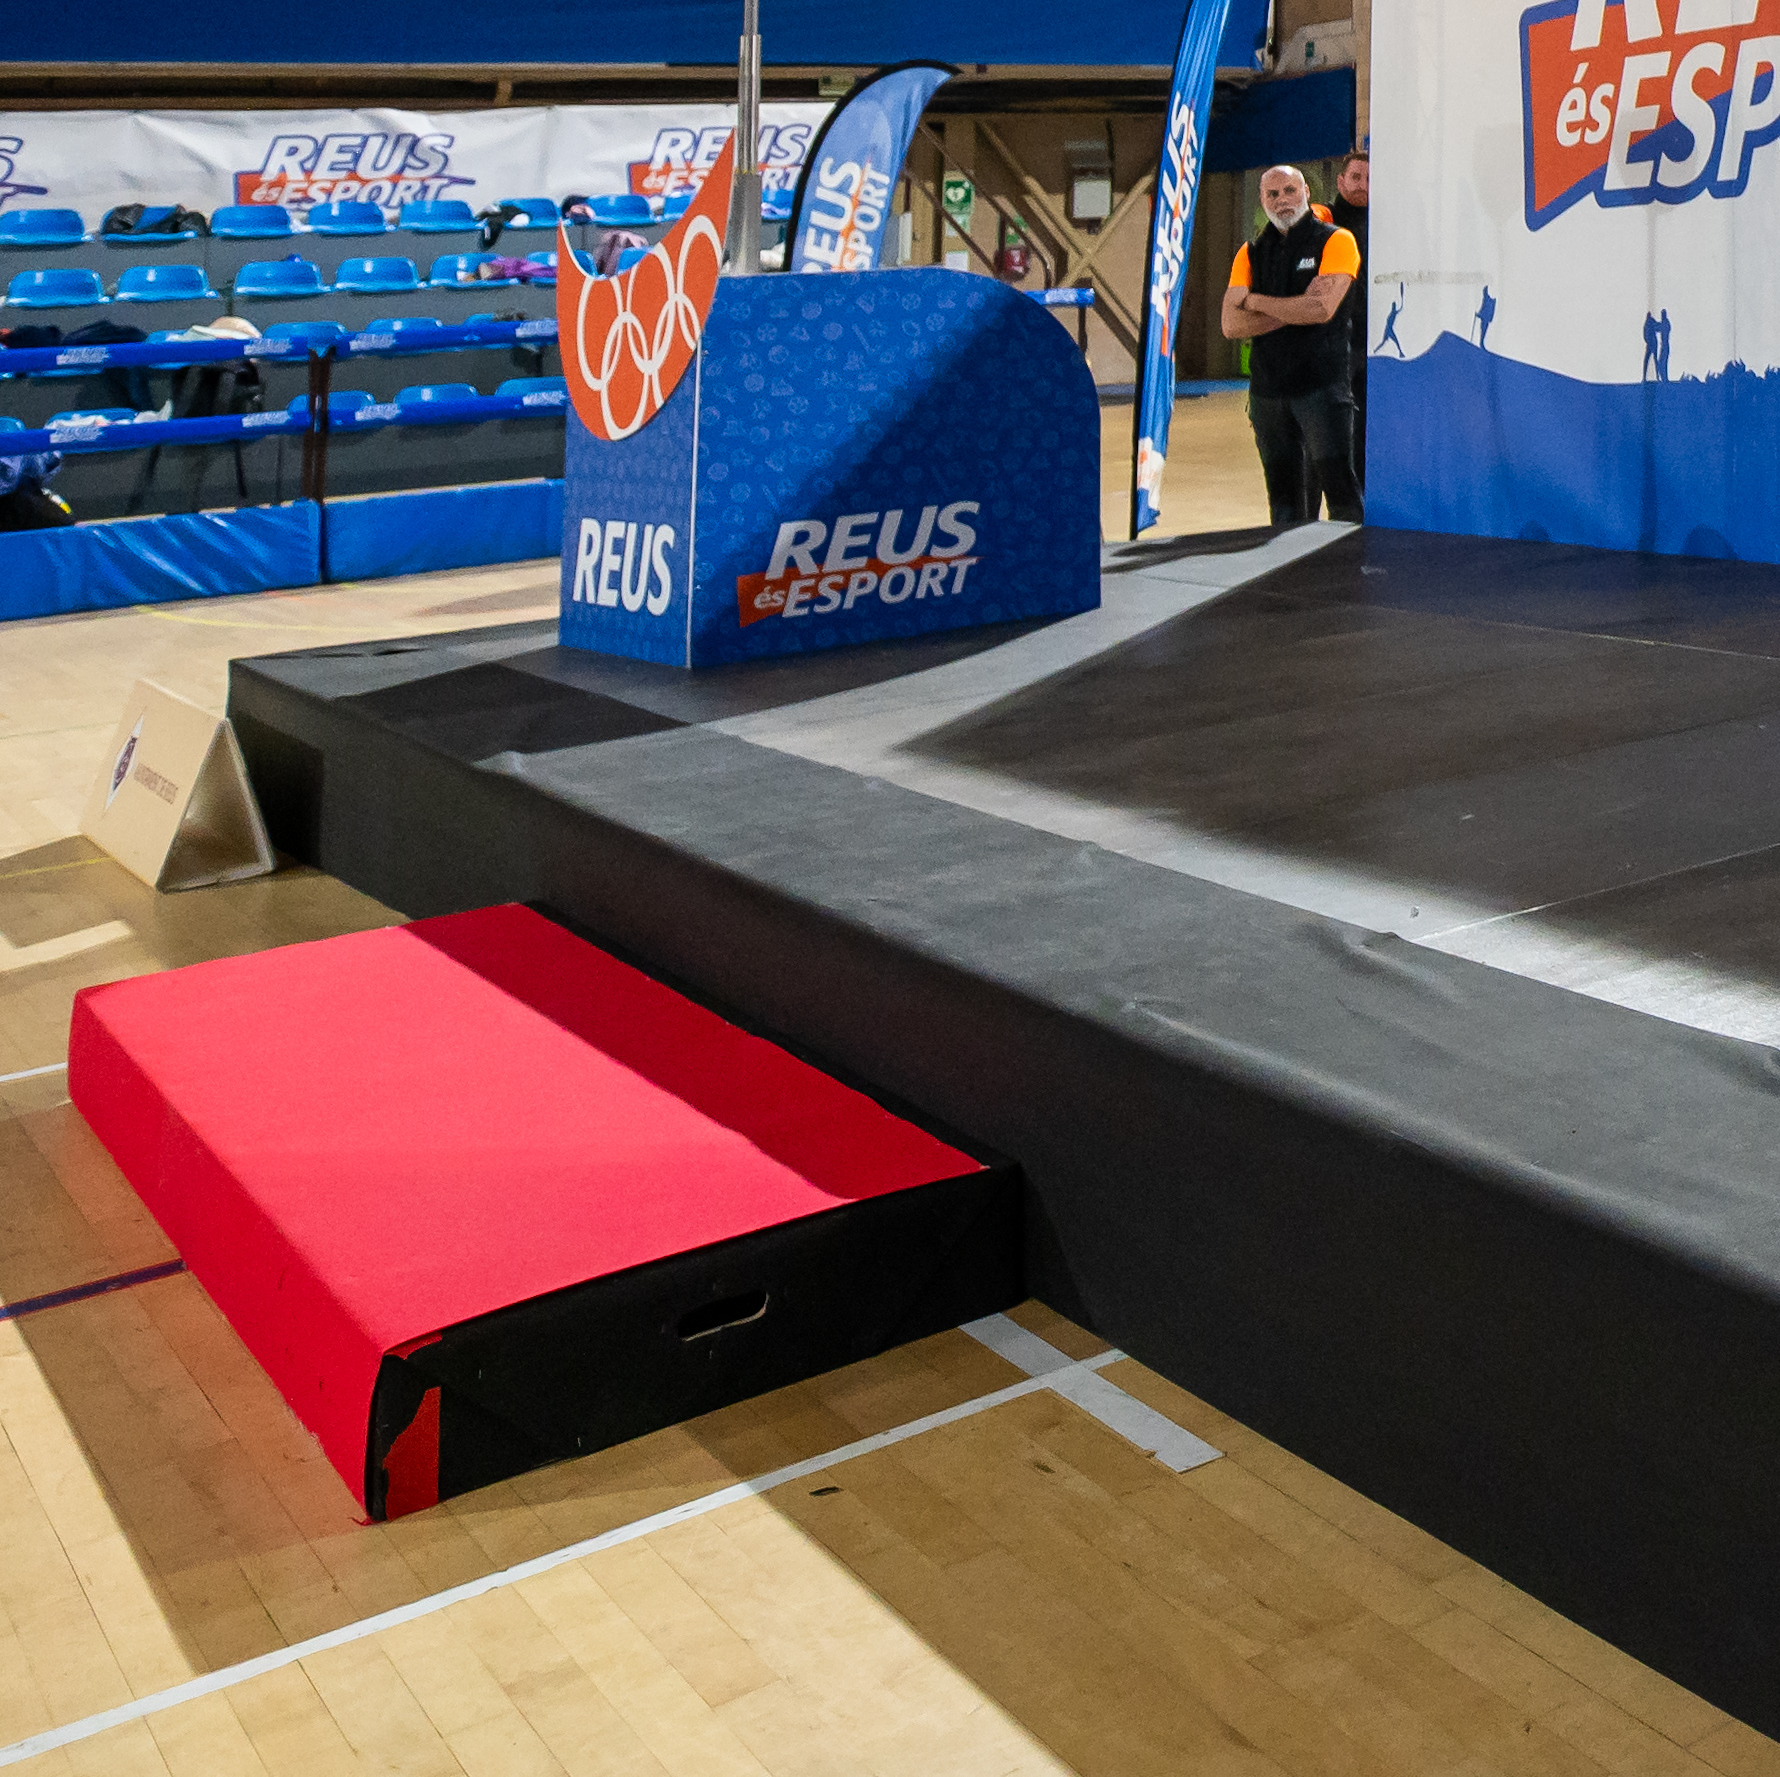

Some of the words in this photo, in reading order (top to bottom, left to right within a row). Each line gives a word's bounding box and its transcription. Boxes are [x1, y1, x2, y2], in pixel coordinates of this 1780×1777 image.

[1555, 62, 1614, 147] és
[258, 133, 454, 181] REUS
[276, 179, 449, 209] ESPORT
[842, 162, 890, 272] SPORT
[572, 516, 675, 617] REUS
[765, 500, 980, 581] REUS
[754, 585, 787, 610] és
[782, 556, 979, 619] ESPORT
